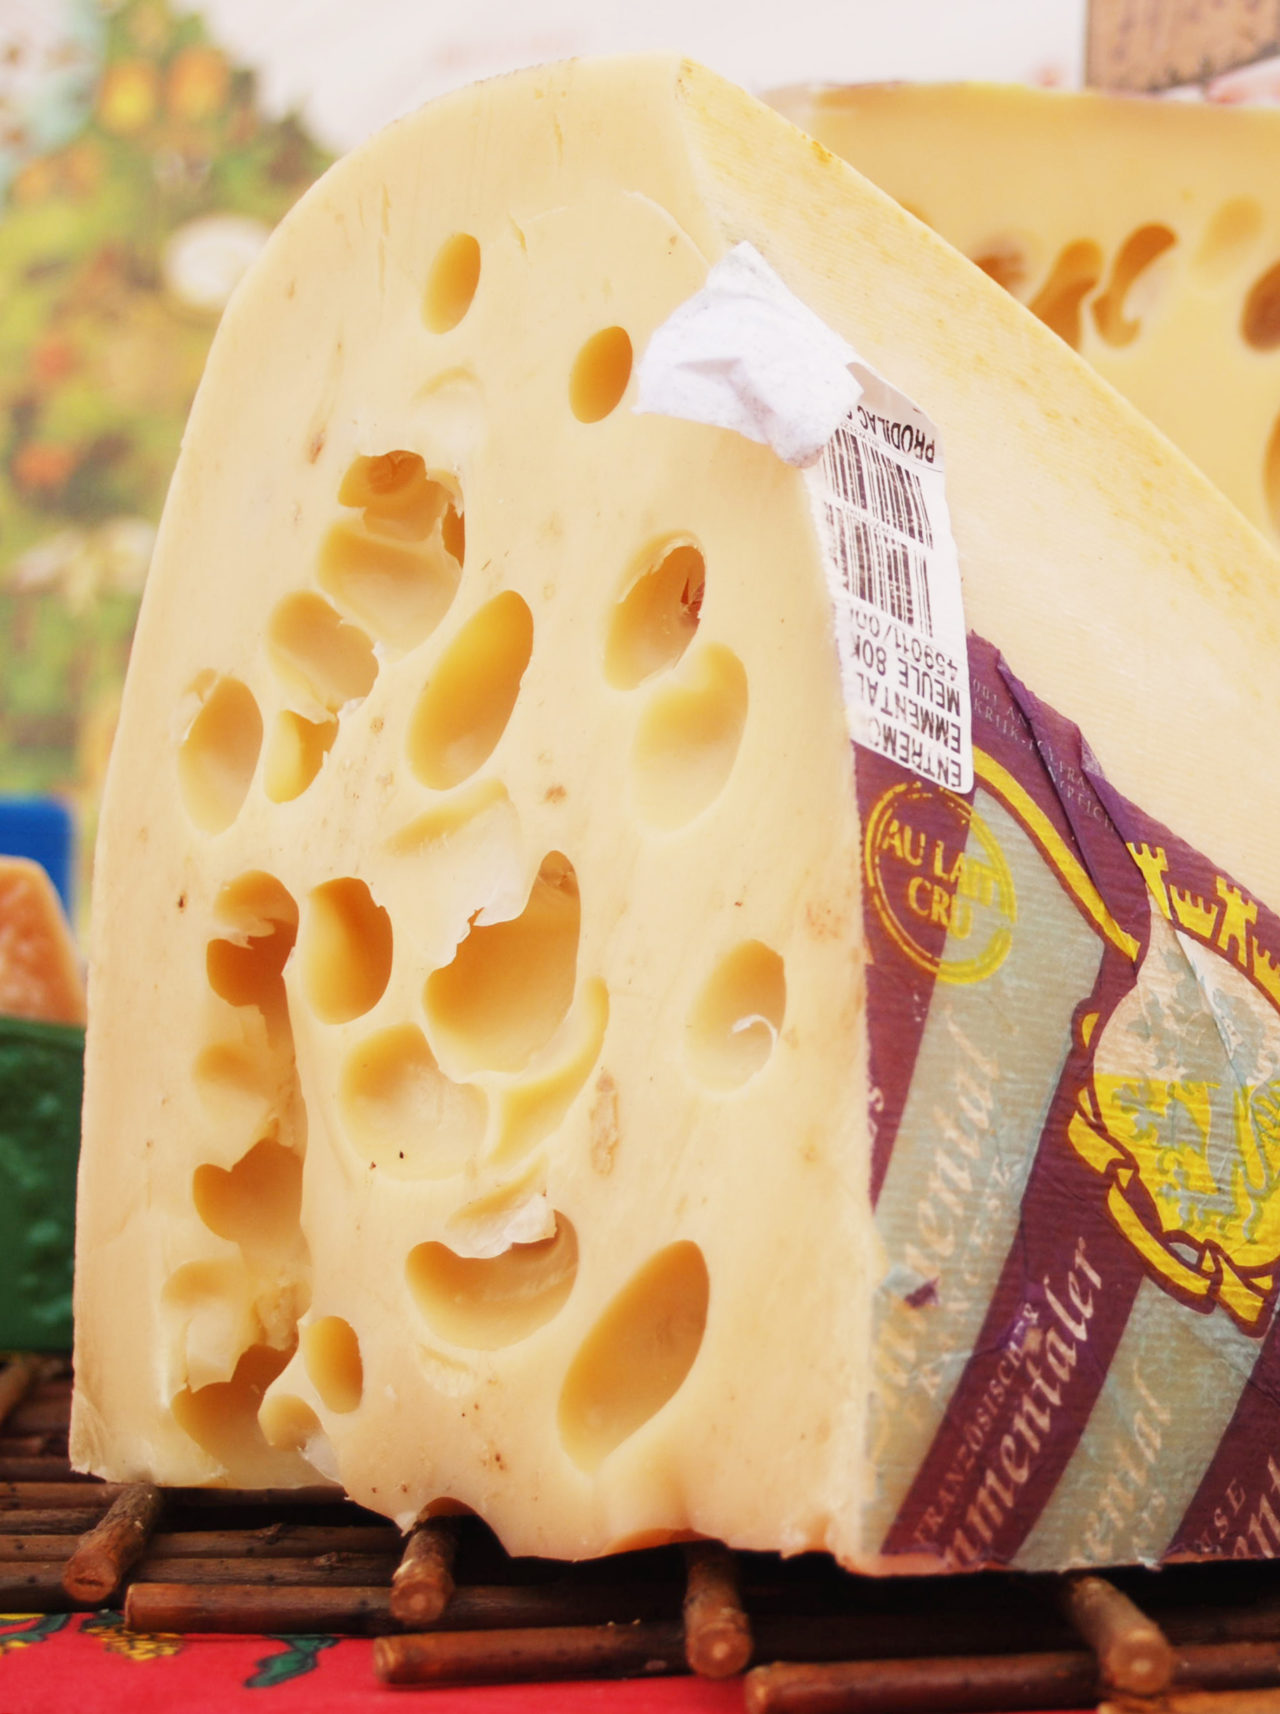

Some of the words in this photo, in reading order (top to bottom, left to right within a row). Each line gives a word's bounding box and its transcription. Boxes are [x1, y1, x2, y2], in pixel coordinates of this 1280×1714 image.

[857, 405, 936, 463] PRODILAC
[856, 671, 962, 755] EMMENTAL
[897, 657, 961, 717] MEULE
[881, 818, 927, 867] AU
[933, 840, 1000, 907] LAIT
[907, 875, 975, 941] CRU
